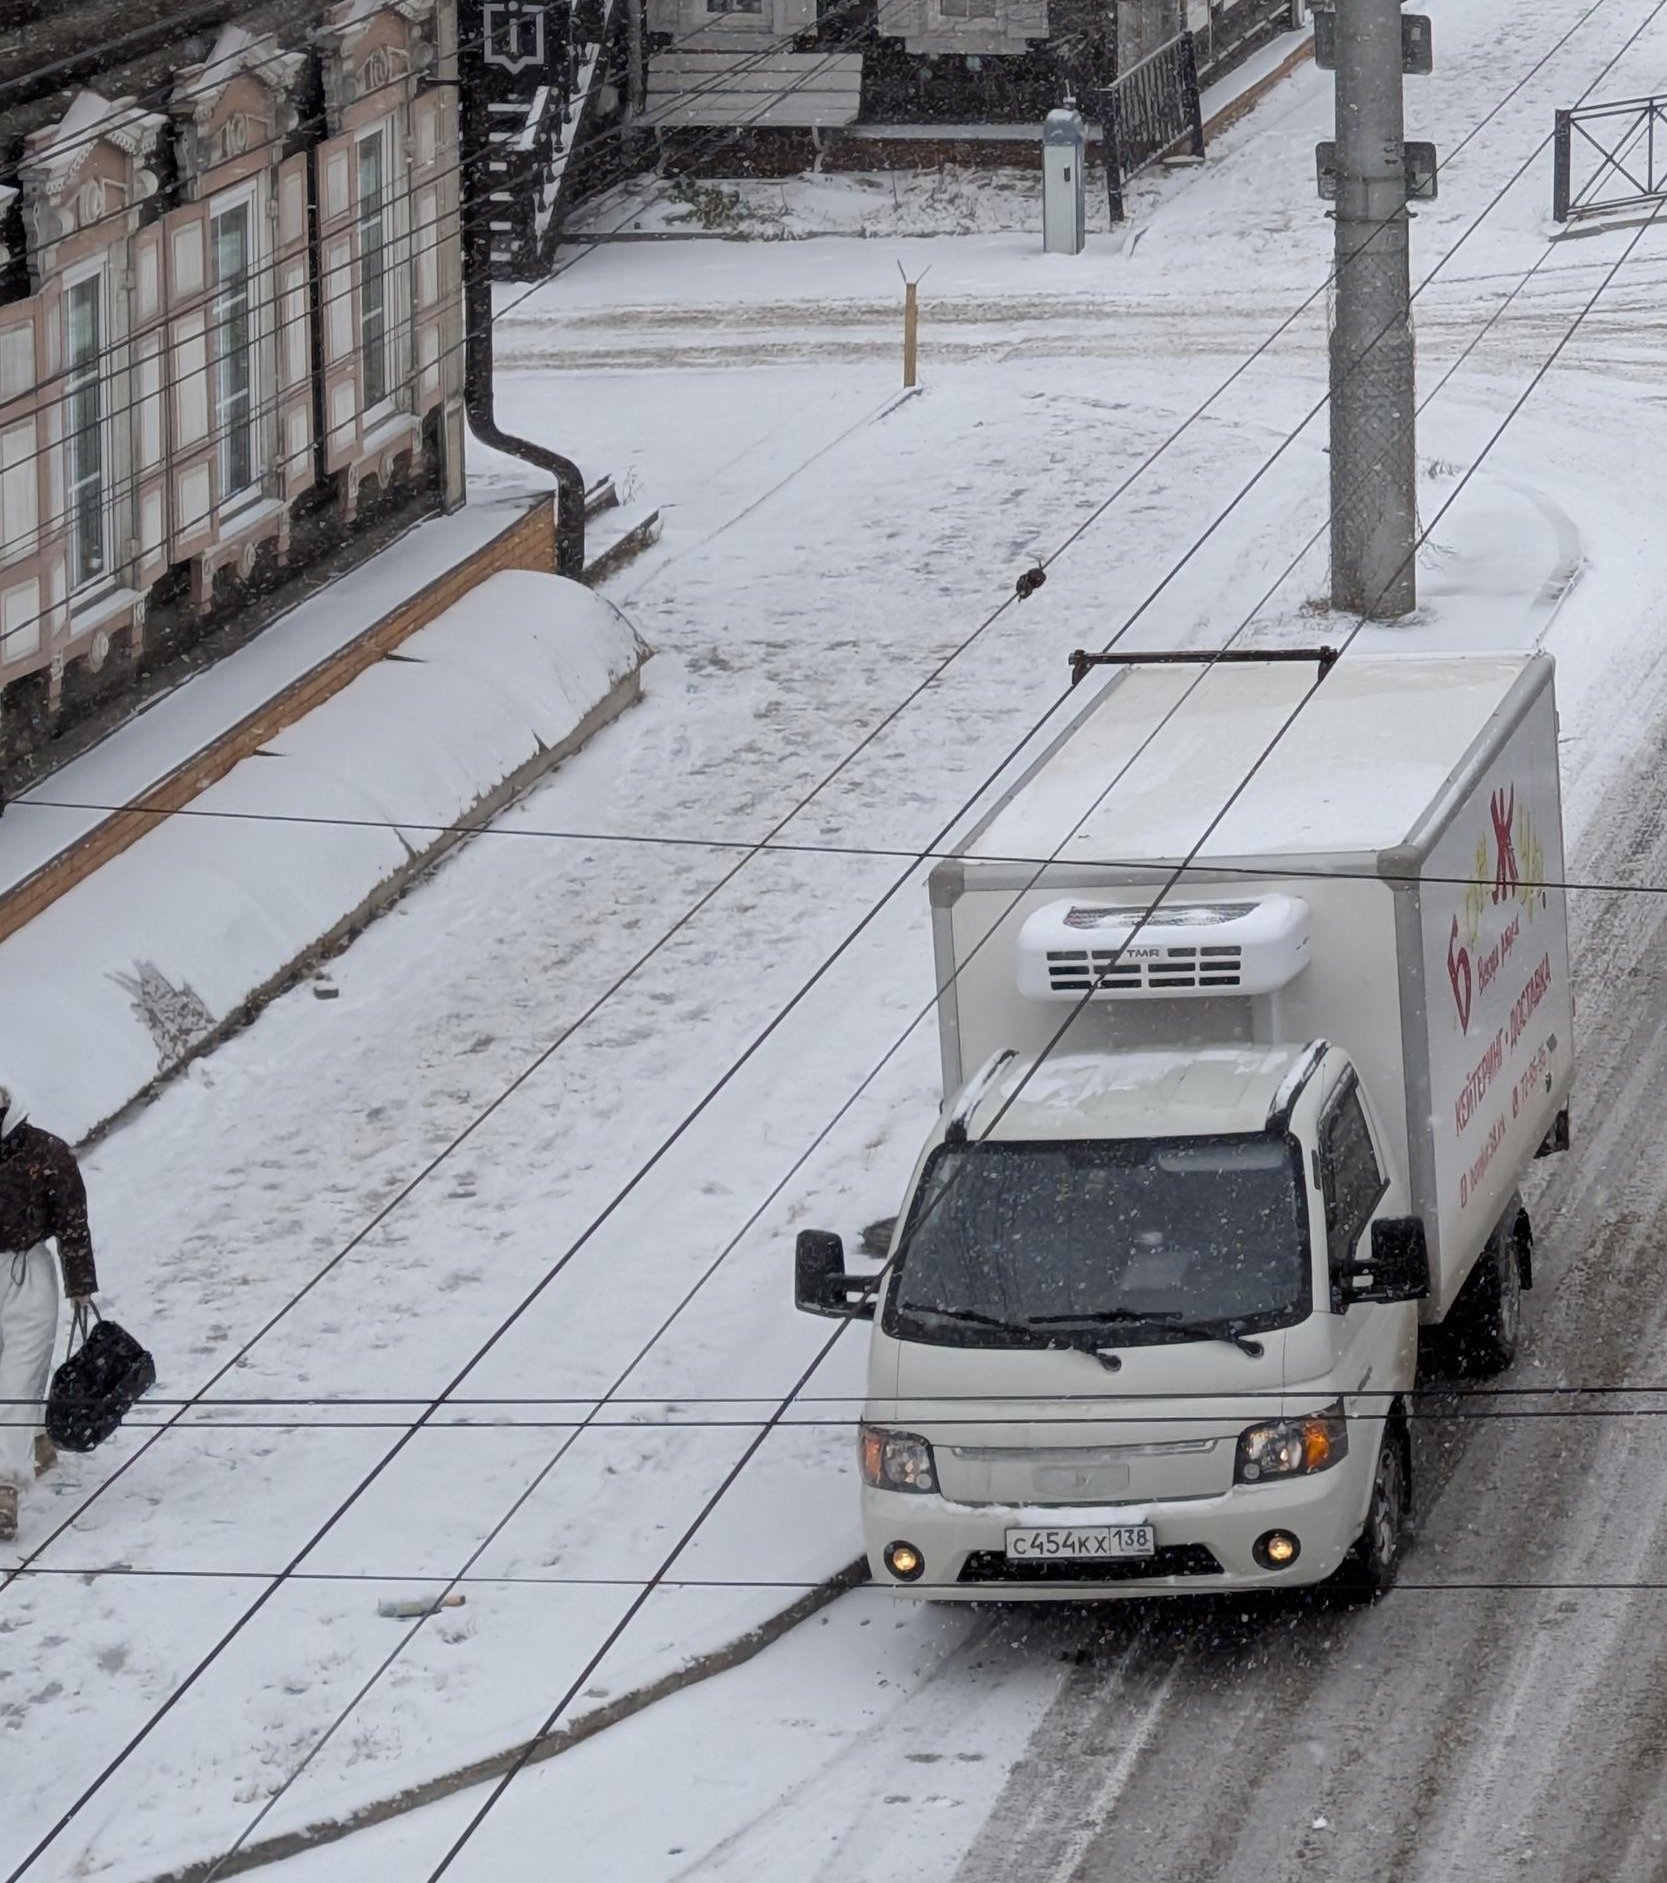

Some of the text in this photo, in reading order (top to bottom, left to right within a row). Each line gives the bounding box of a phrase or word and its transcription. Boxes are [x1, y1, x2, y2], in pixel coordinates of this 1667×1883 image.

[1126, 949, 1160, 958] TMR
[1013, 1528, 1148, 1555] С454КХ 138
